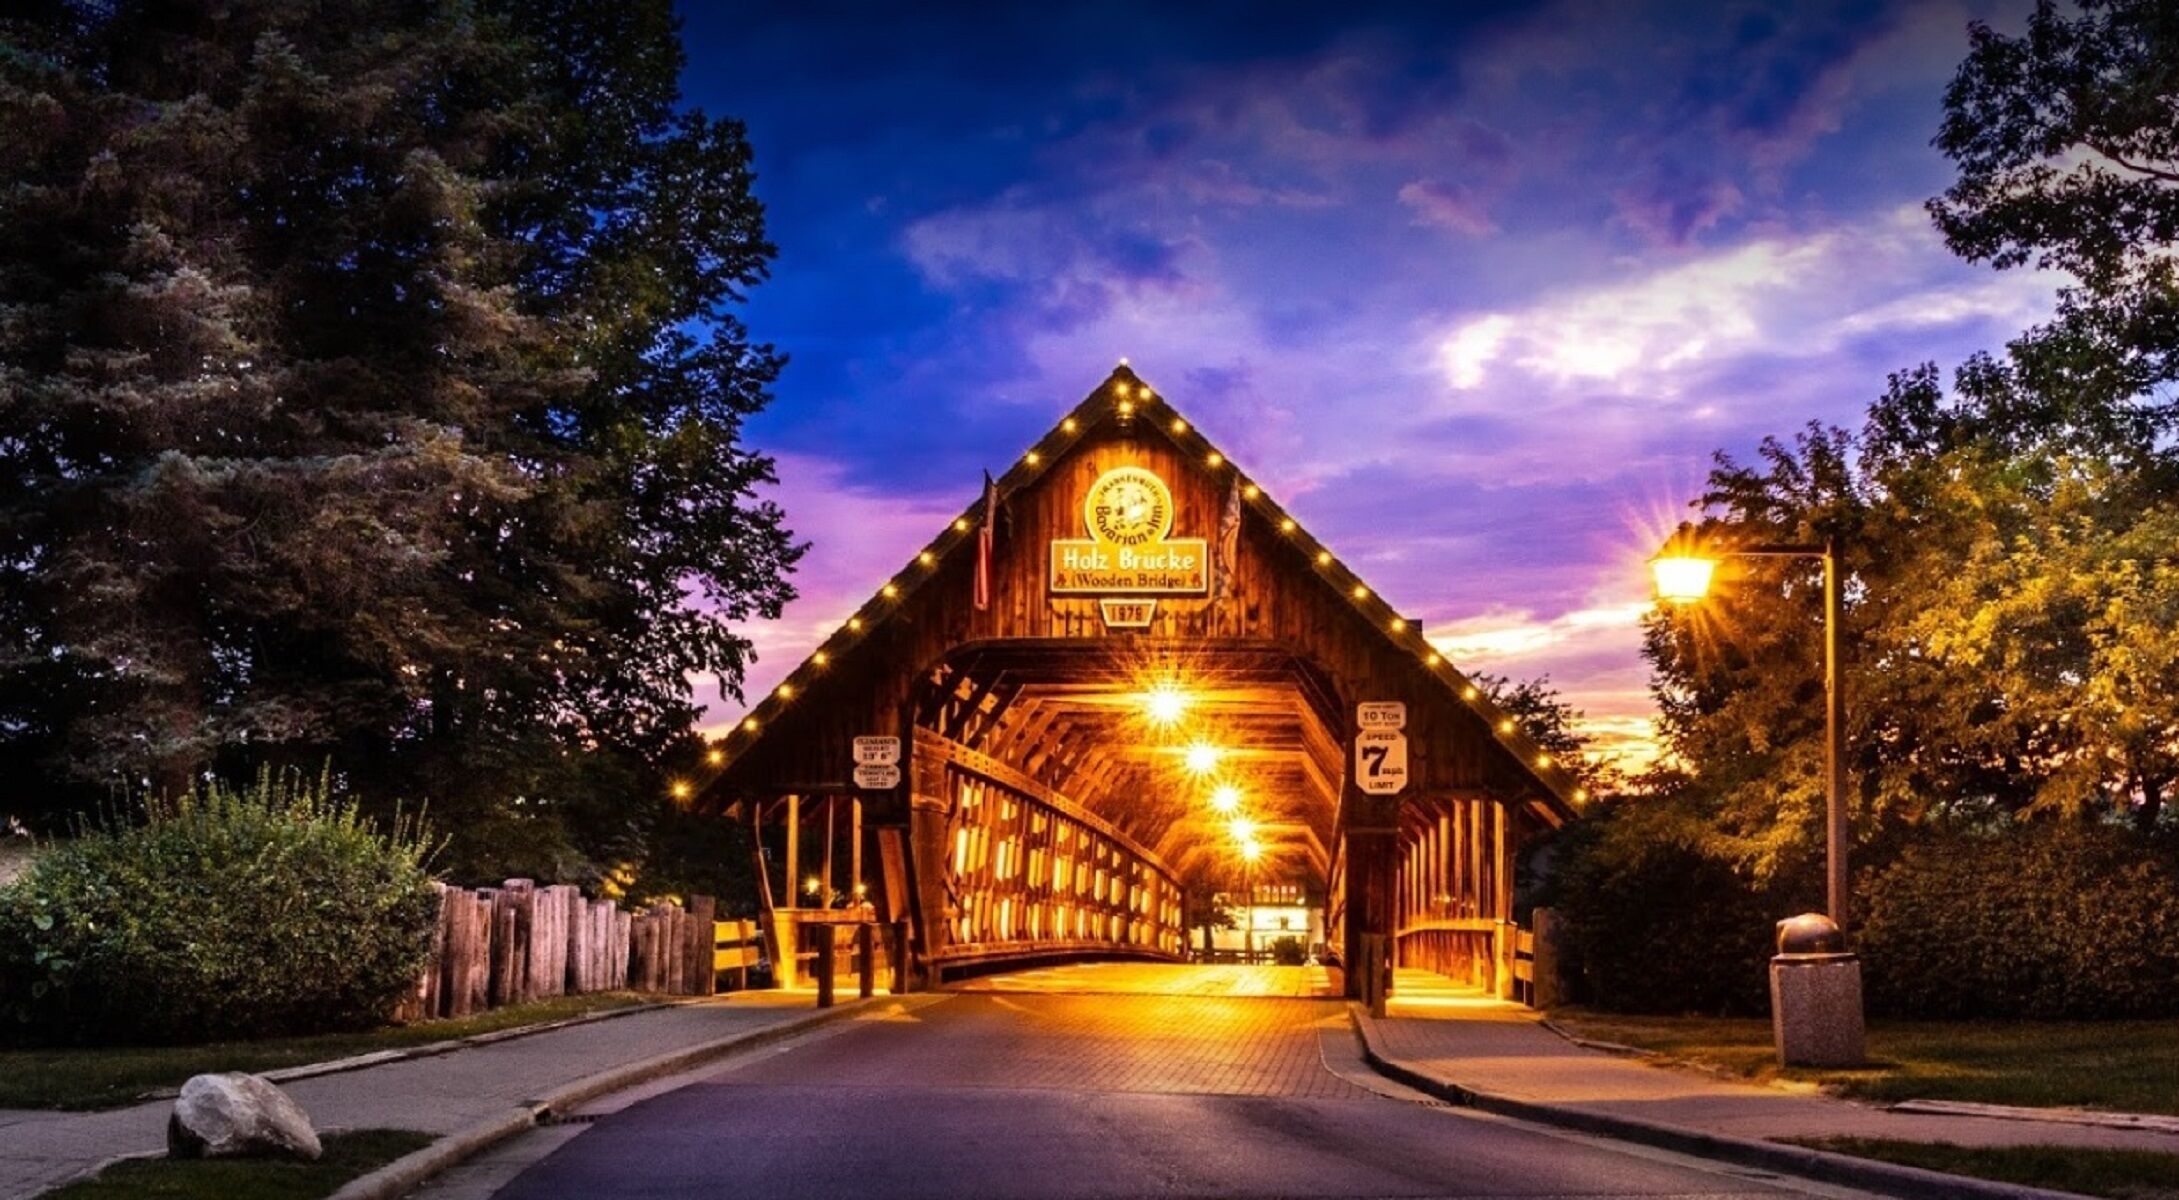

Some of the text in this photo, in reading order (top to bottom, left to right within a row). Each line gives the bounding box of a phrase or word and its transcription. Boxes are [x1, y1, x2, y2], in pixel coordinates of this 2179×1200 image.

[1096, 505, 1163, 545] Bavarian Inn
[1063, 548, 1195, 570] Holz Brücke
[1072, 573, 1186, 588] (Wooden Bridge)
[1363, 711, 1378, 721] 10
[1366, 733, 1397, 741] SPEED
[1362, 745, 1389, 777] 7
[1368, 781, 1394, 789] LIMIT
